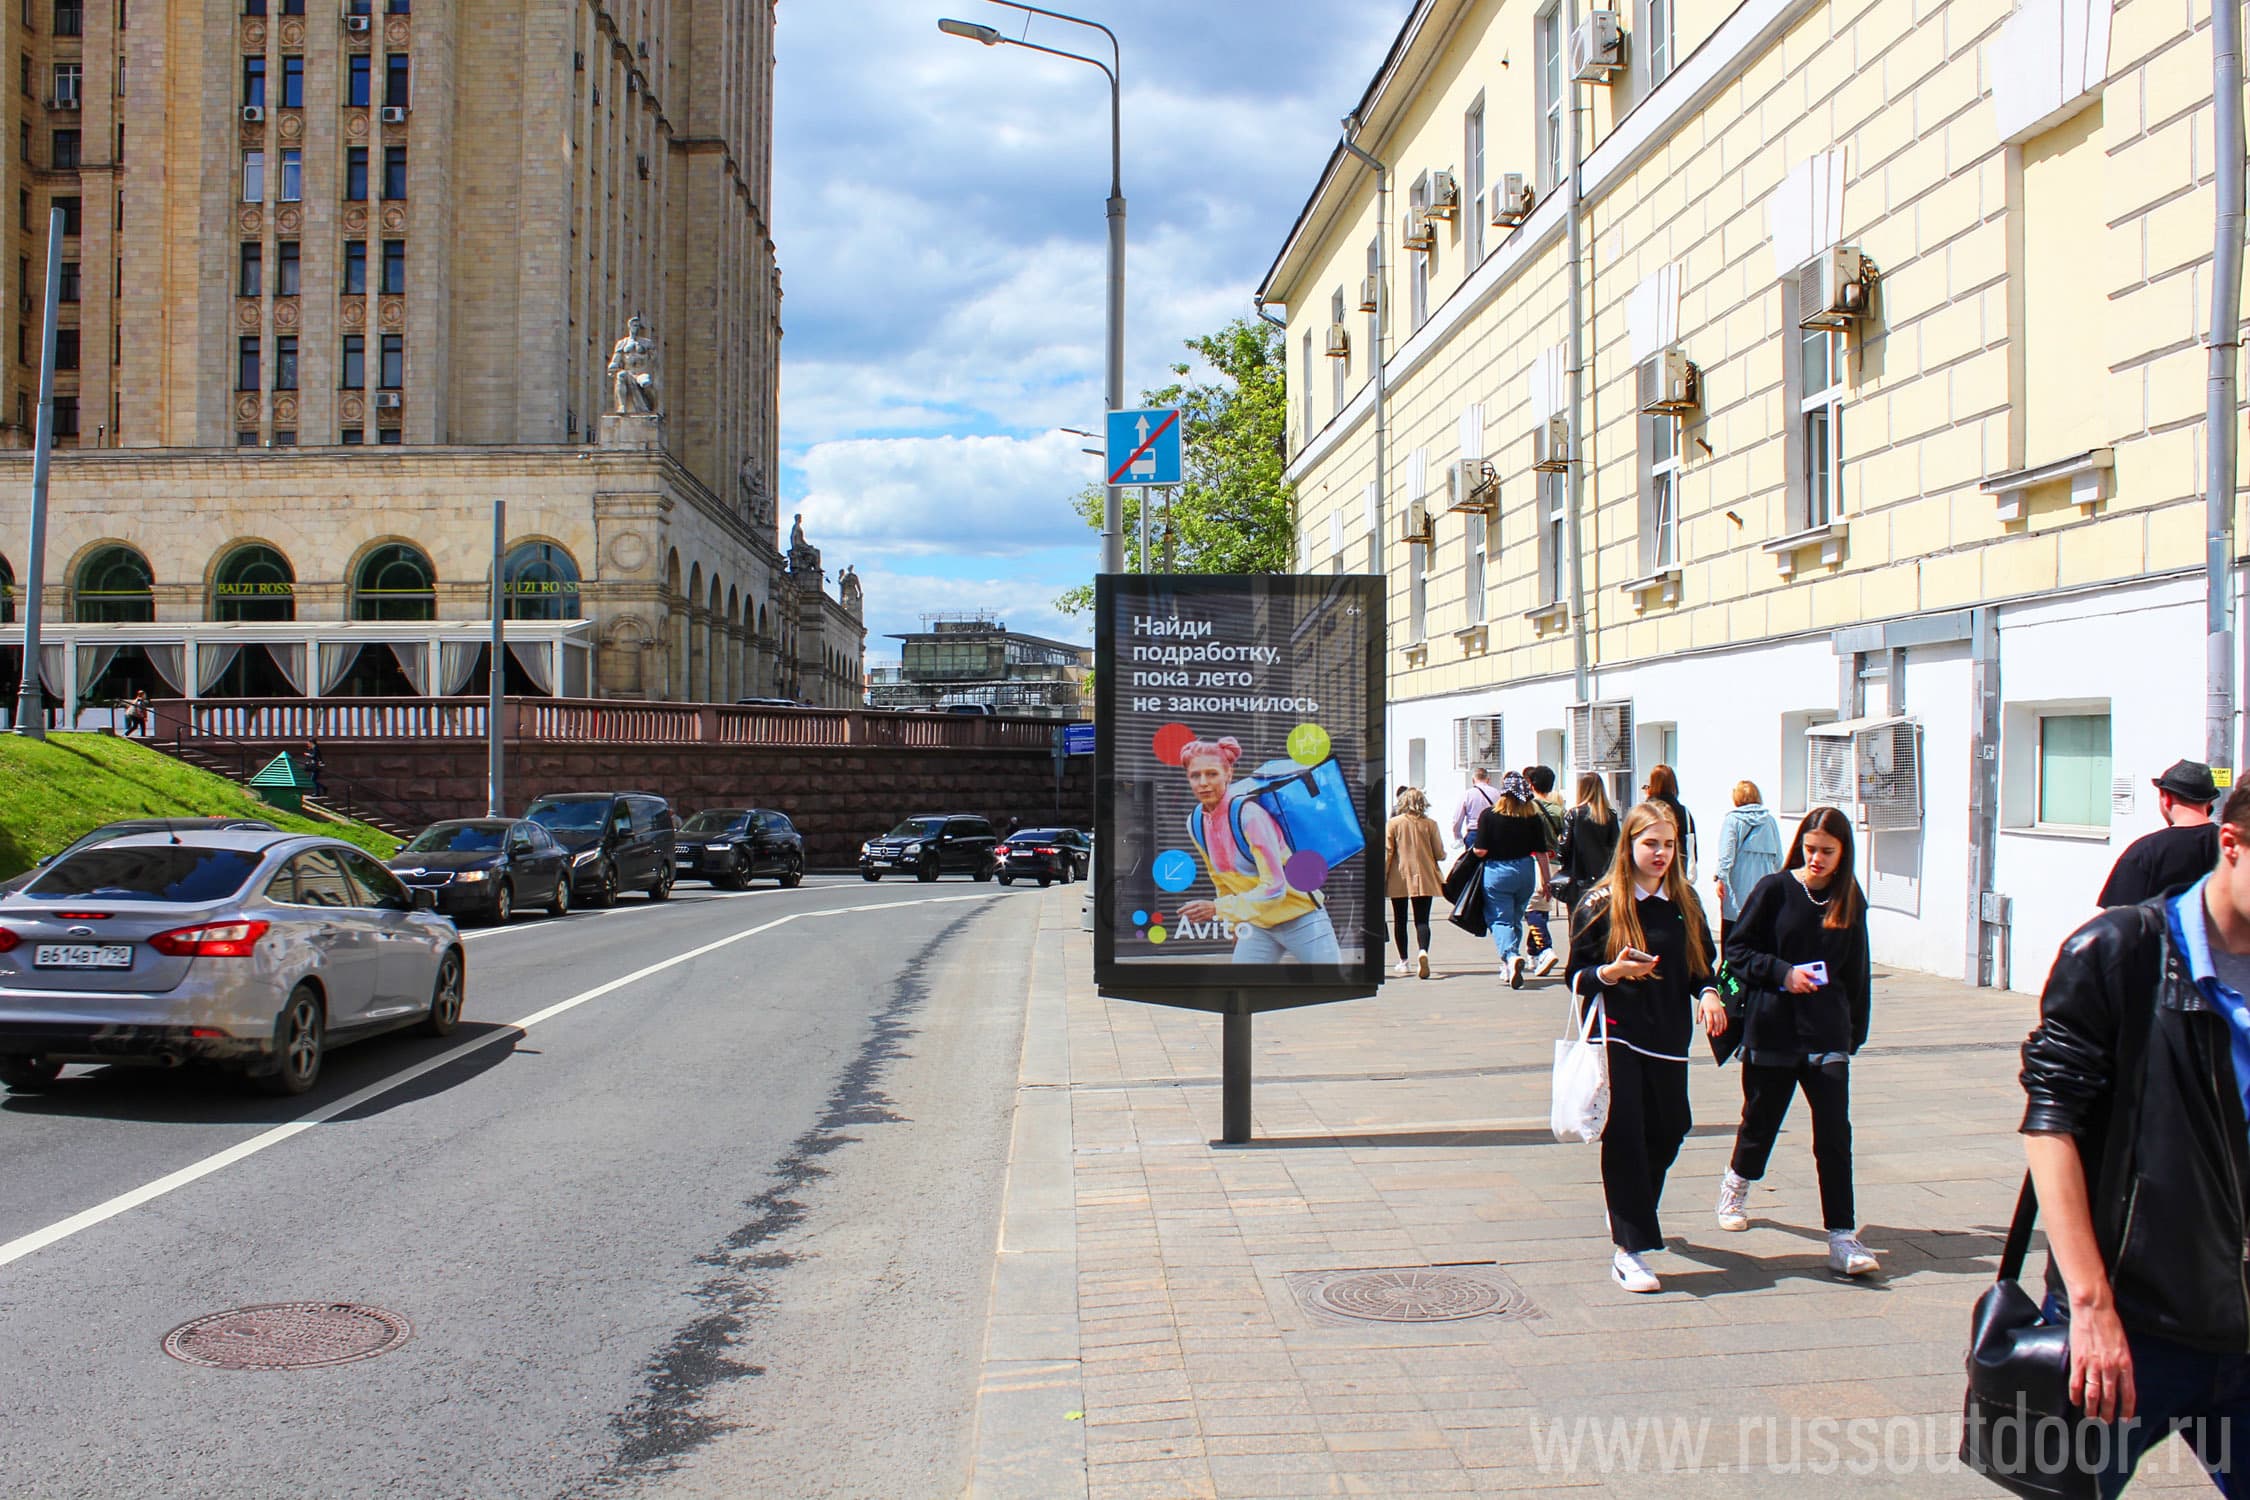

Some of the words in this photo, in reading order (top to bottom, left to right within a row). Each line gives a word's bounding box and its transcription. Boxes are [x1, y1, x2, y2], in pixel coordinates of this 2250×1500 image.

[217, 583, 253, 594] BALZI
[1346, 604, 1361, 616] 6+
[1134, 615, 1212, 640] Найди
[1133, 641, 1281, 666] подработку,
[1133, 671, 1189, 687] пока
[1195, 671, 1253, 687] лето
[1133, 696, 1161, 712] не
[1167, 696, 1320, 712] закончилось
[1174, 913, 1254, 940] Avito
